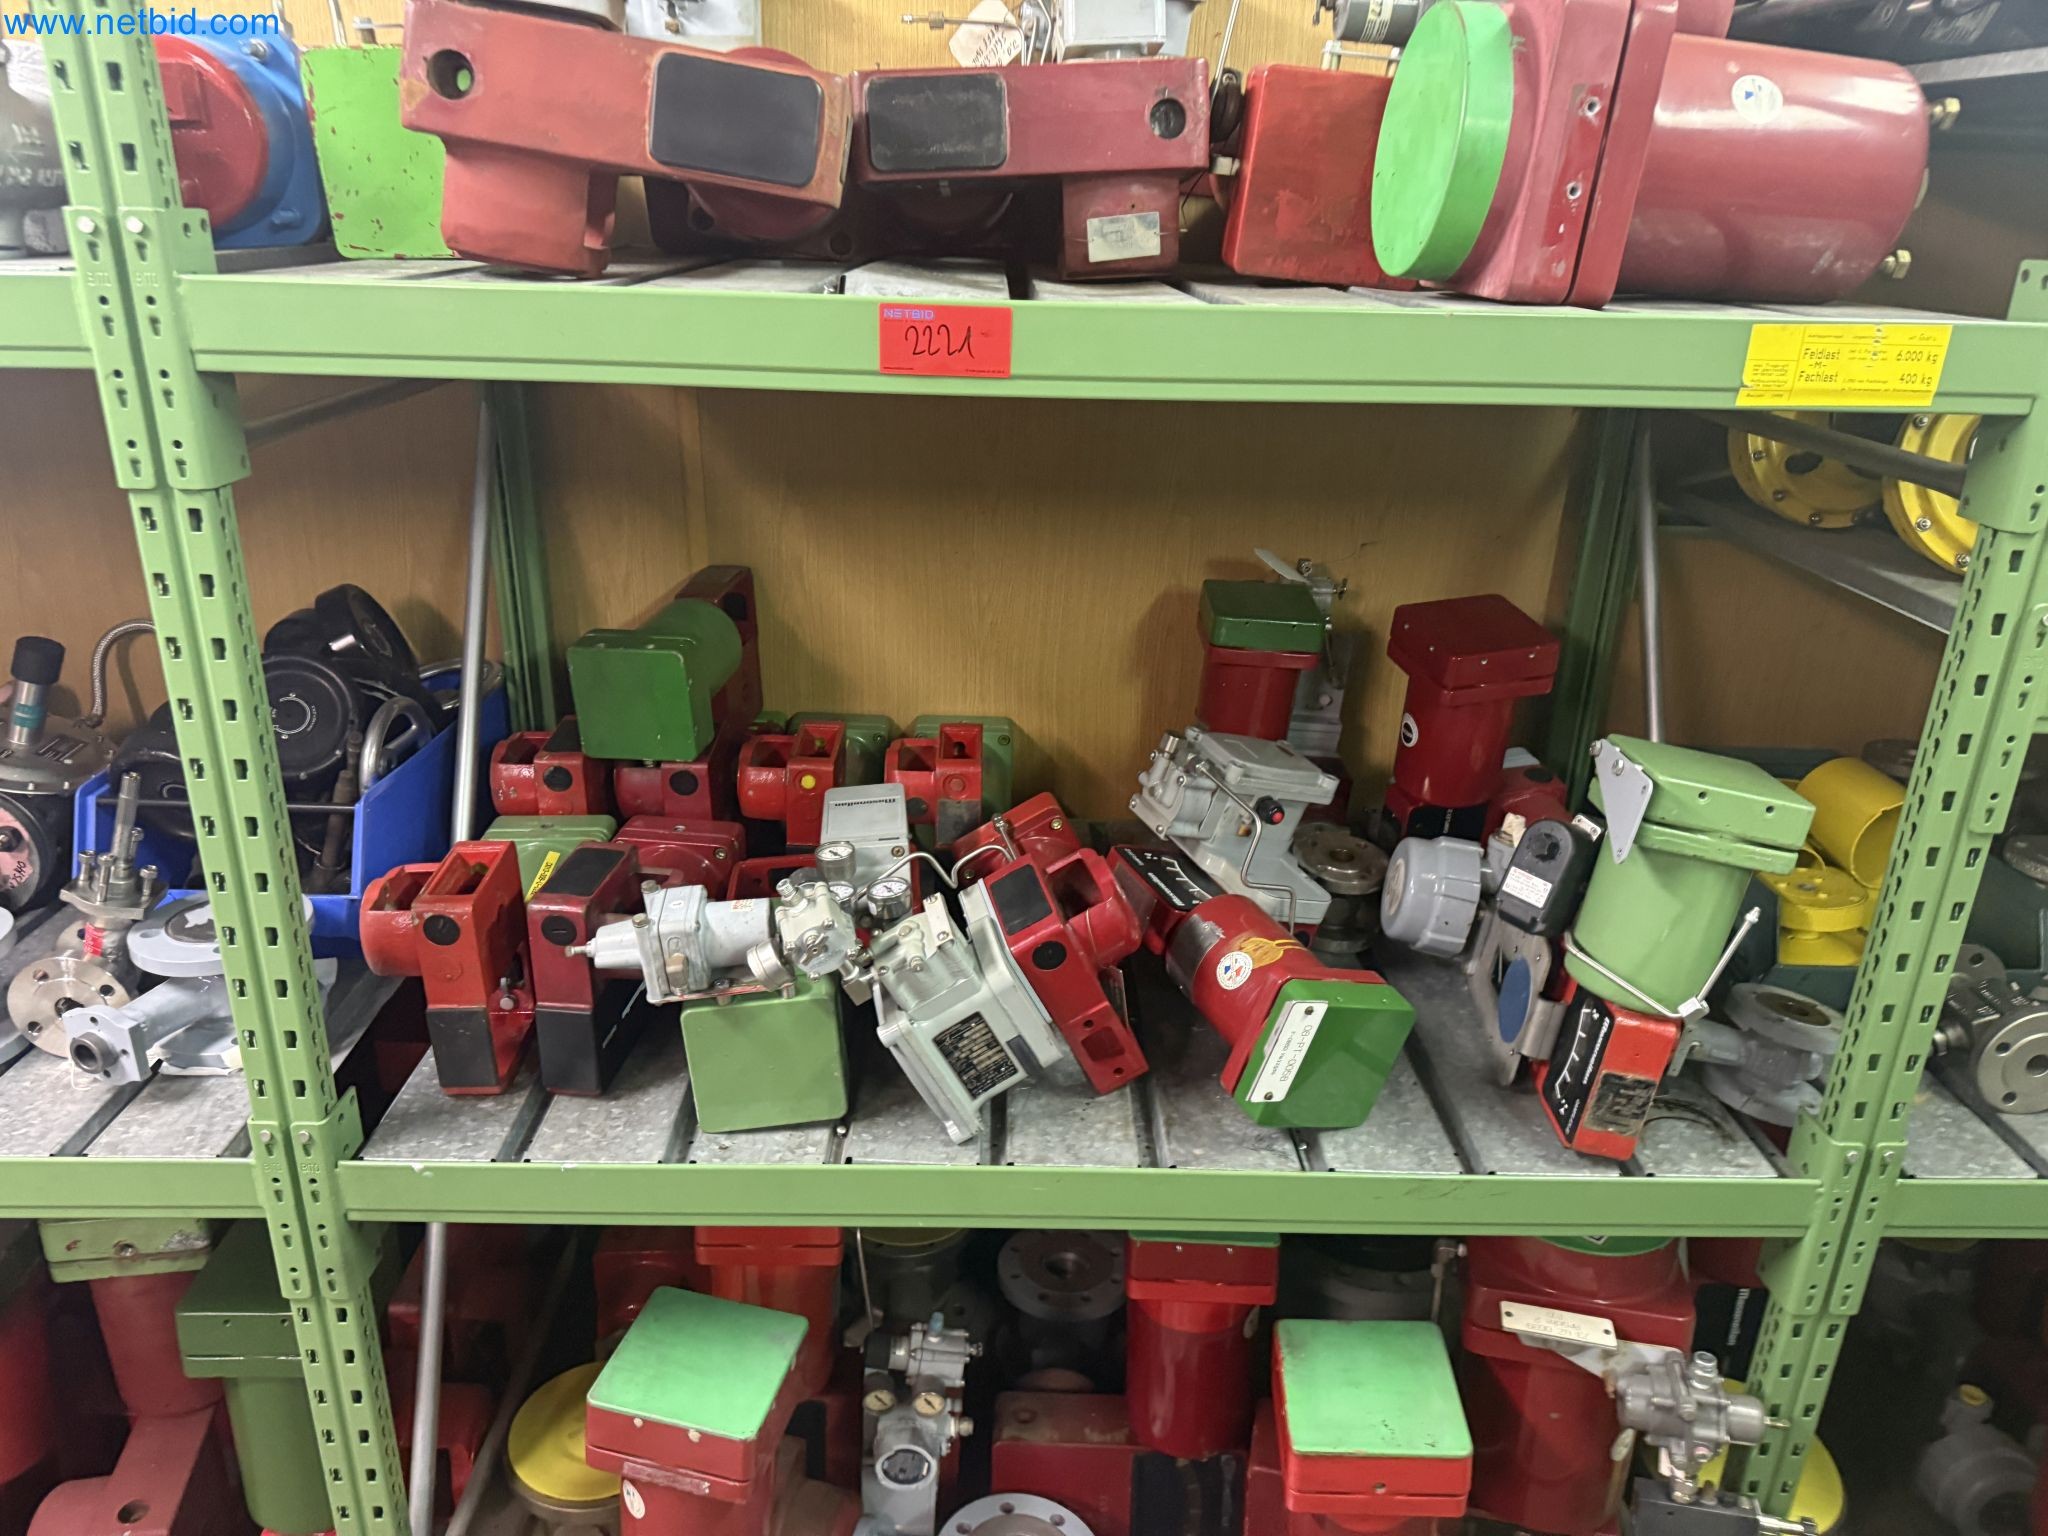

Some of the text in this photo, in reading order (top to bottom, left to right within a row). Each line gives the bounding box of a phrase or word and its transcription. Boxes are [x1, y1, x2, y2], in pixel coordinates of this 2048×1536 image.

[883, 308, 935, 320] NETBID
[905, 324, 975, 359] 2221
[1803, 347, 1840, 360] Feldlast
[1895, 350, 1923, 362] 6.000
[1926, 351, 1938, 364] kg
[1797, 370, 1839, 383] Fachlast
[1900, 373, 1918, 384] 400
[1920, 374, 1933, 387] kg
